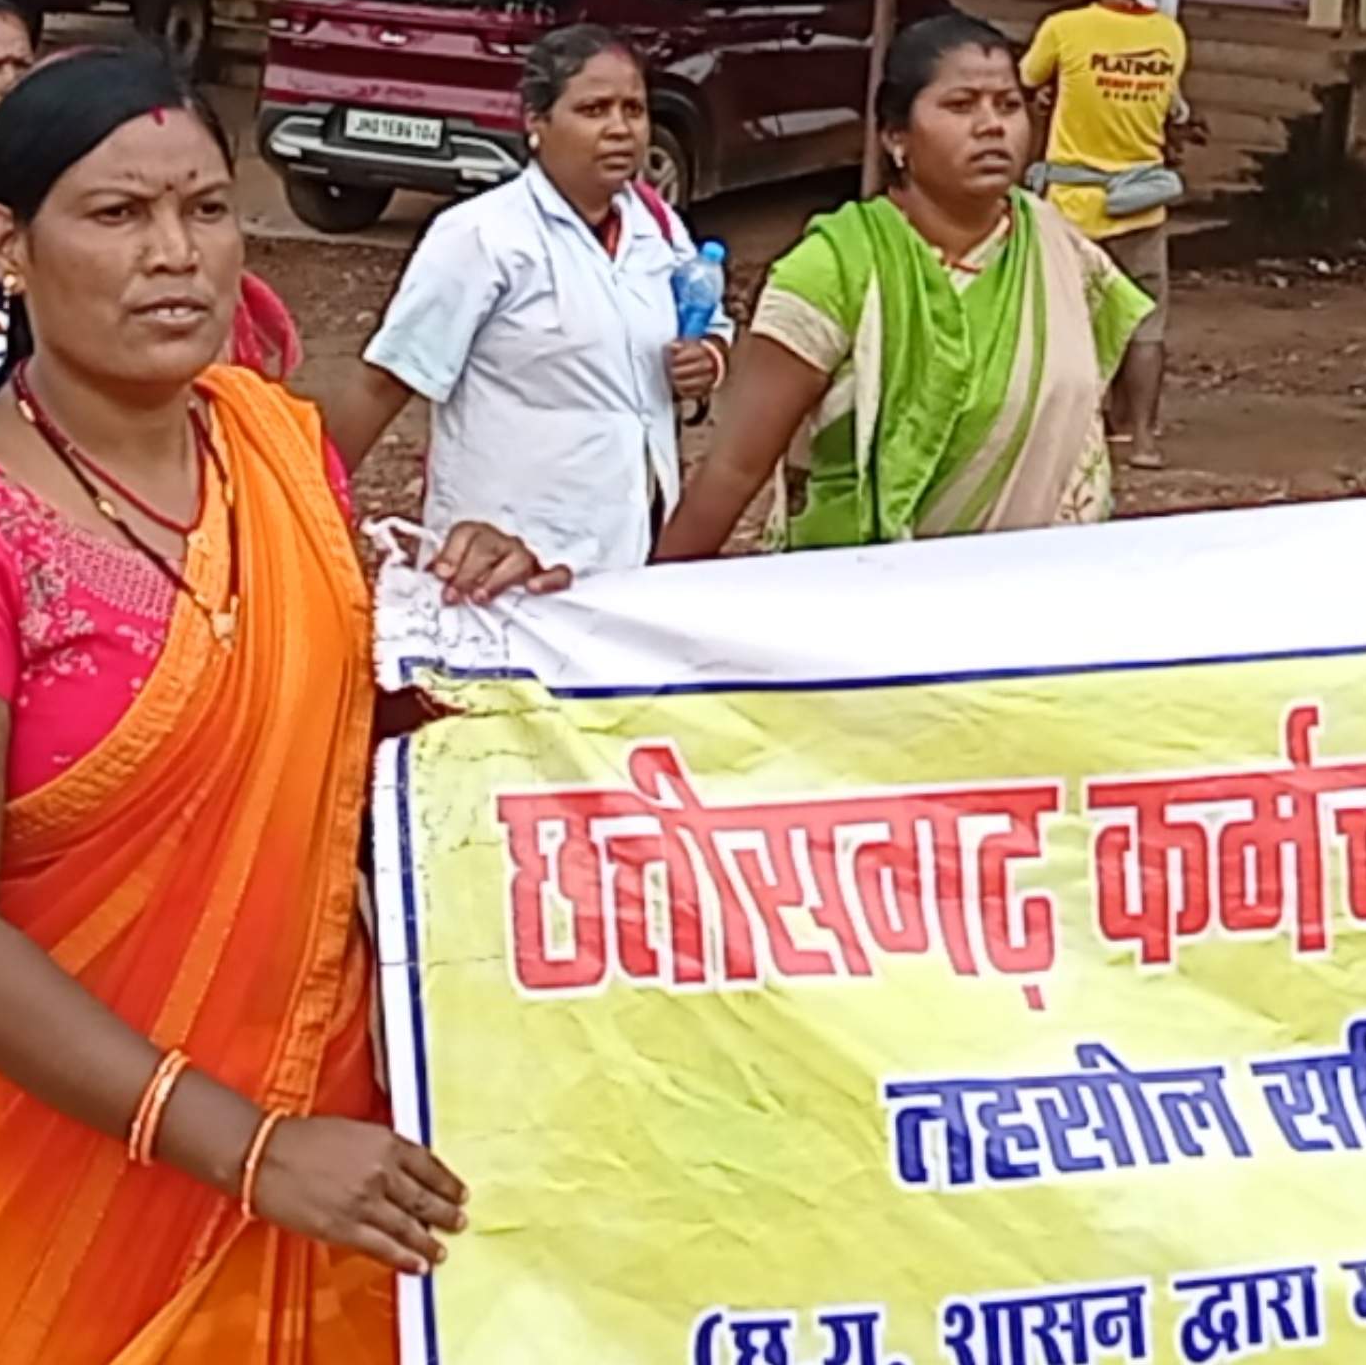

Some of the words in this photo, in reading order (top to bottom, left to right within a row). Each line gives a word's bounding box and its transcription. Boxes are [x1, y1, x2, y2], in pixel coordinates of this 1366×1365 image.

[497, 746, 1059, 1011] छत्तीसगढ़
[885, 1043, 1252, 1185] तहसील
[1173, 1267, 1317, 1363] द्वारा
